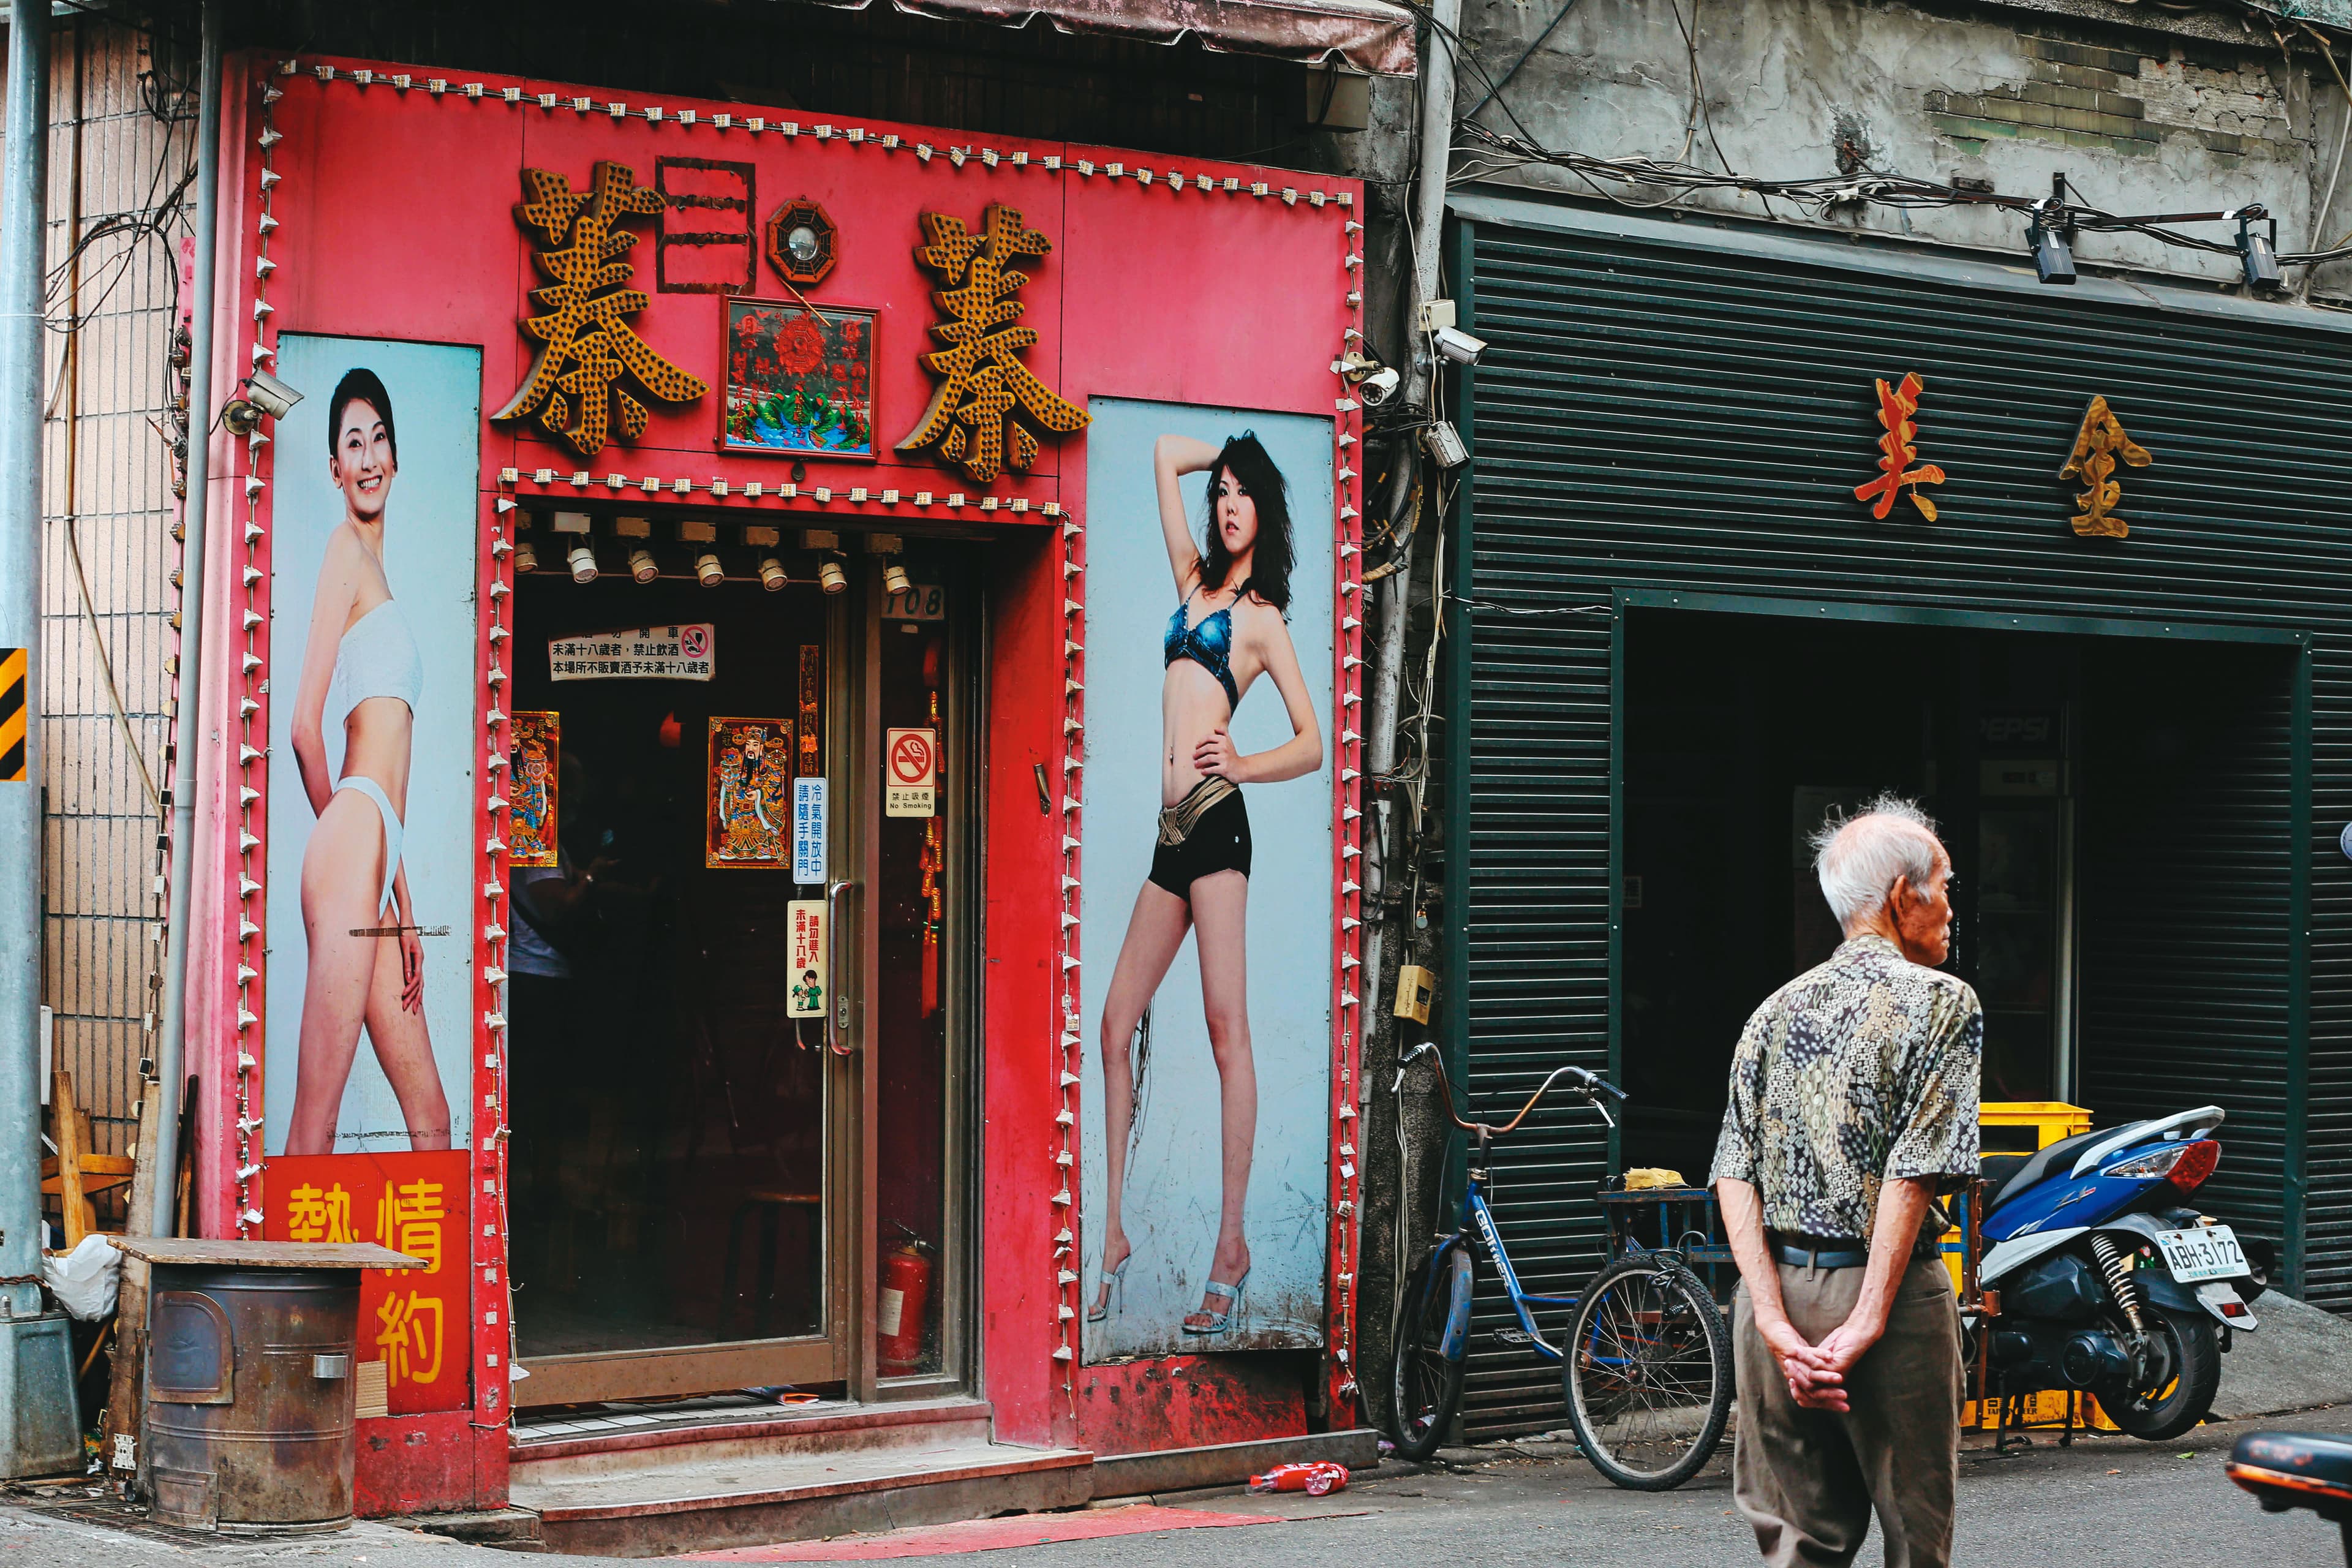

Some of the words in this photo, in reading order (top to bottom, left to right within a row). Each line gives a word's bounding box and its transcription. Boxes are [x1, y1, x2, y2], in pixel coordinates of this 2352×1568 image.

[552, 643, 679, 657] 未滿十八歲者，禁止飲酒
[552, 661, 710, 674] 本場所不販賣酒予未滿十八歲者
[798, 785, 809, 876] 請隨手關門
[811, 784, 822, 876] 冷氣開放中
[796, 909, 806, 969] 未滿十八歲
[809, 915, 819, 963] 請勿進入
[2167, 1240, 2244, 1270] ABH-3172
